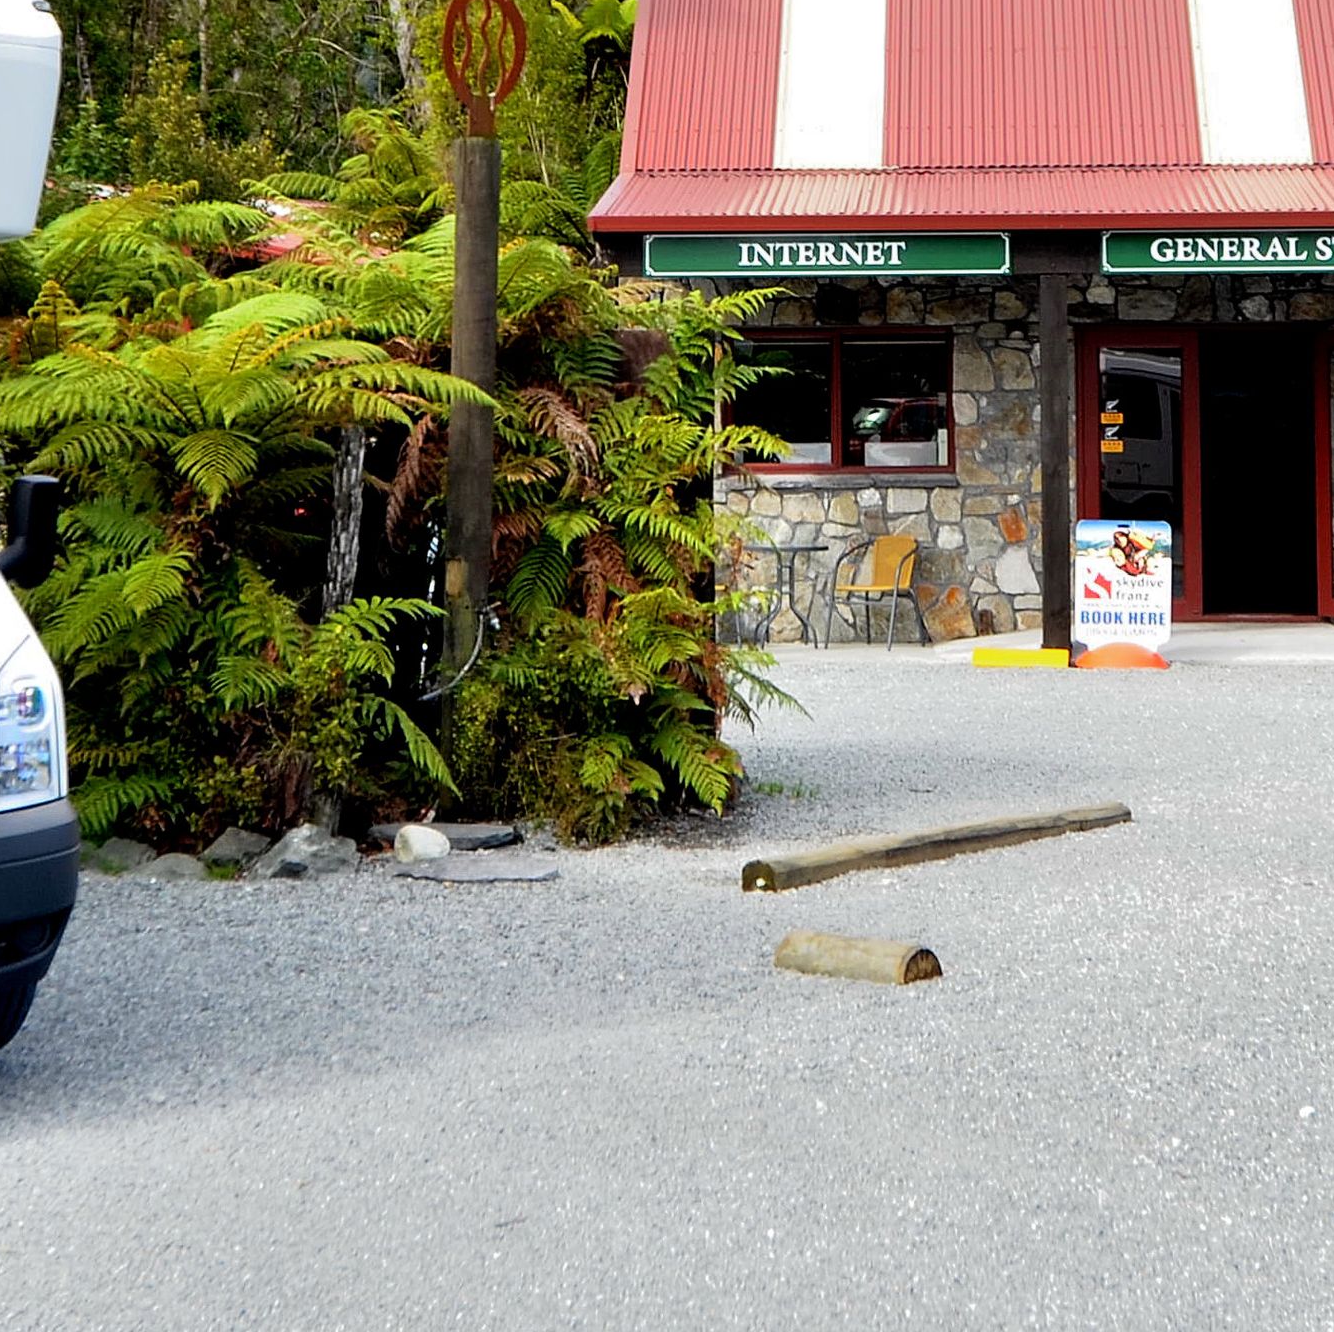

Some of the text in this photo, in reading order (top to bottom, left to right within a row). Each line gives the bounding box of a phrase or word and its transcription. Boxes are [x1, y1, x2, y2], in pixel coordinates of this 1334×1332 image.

[738, 241, 906, 266] INTERNET
[1150, 237, 1307, 262] GENERAL
[1116, 577, 1164, 589] skydive
[1116, 591, 1149, 601] franz
[1080, 610, 1166, 626] BOOK HERE
